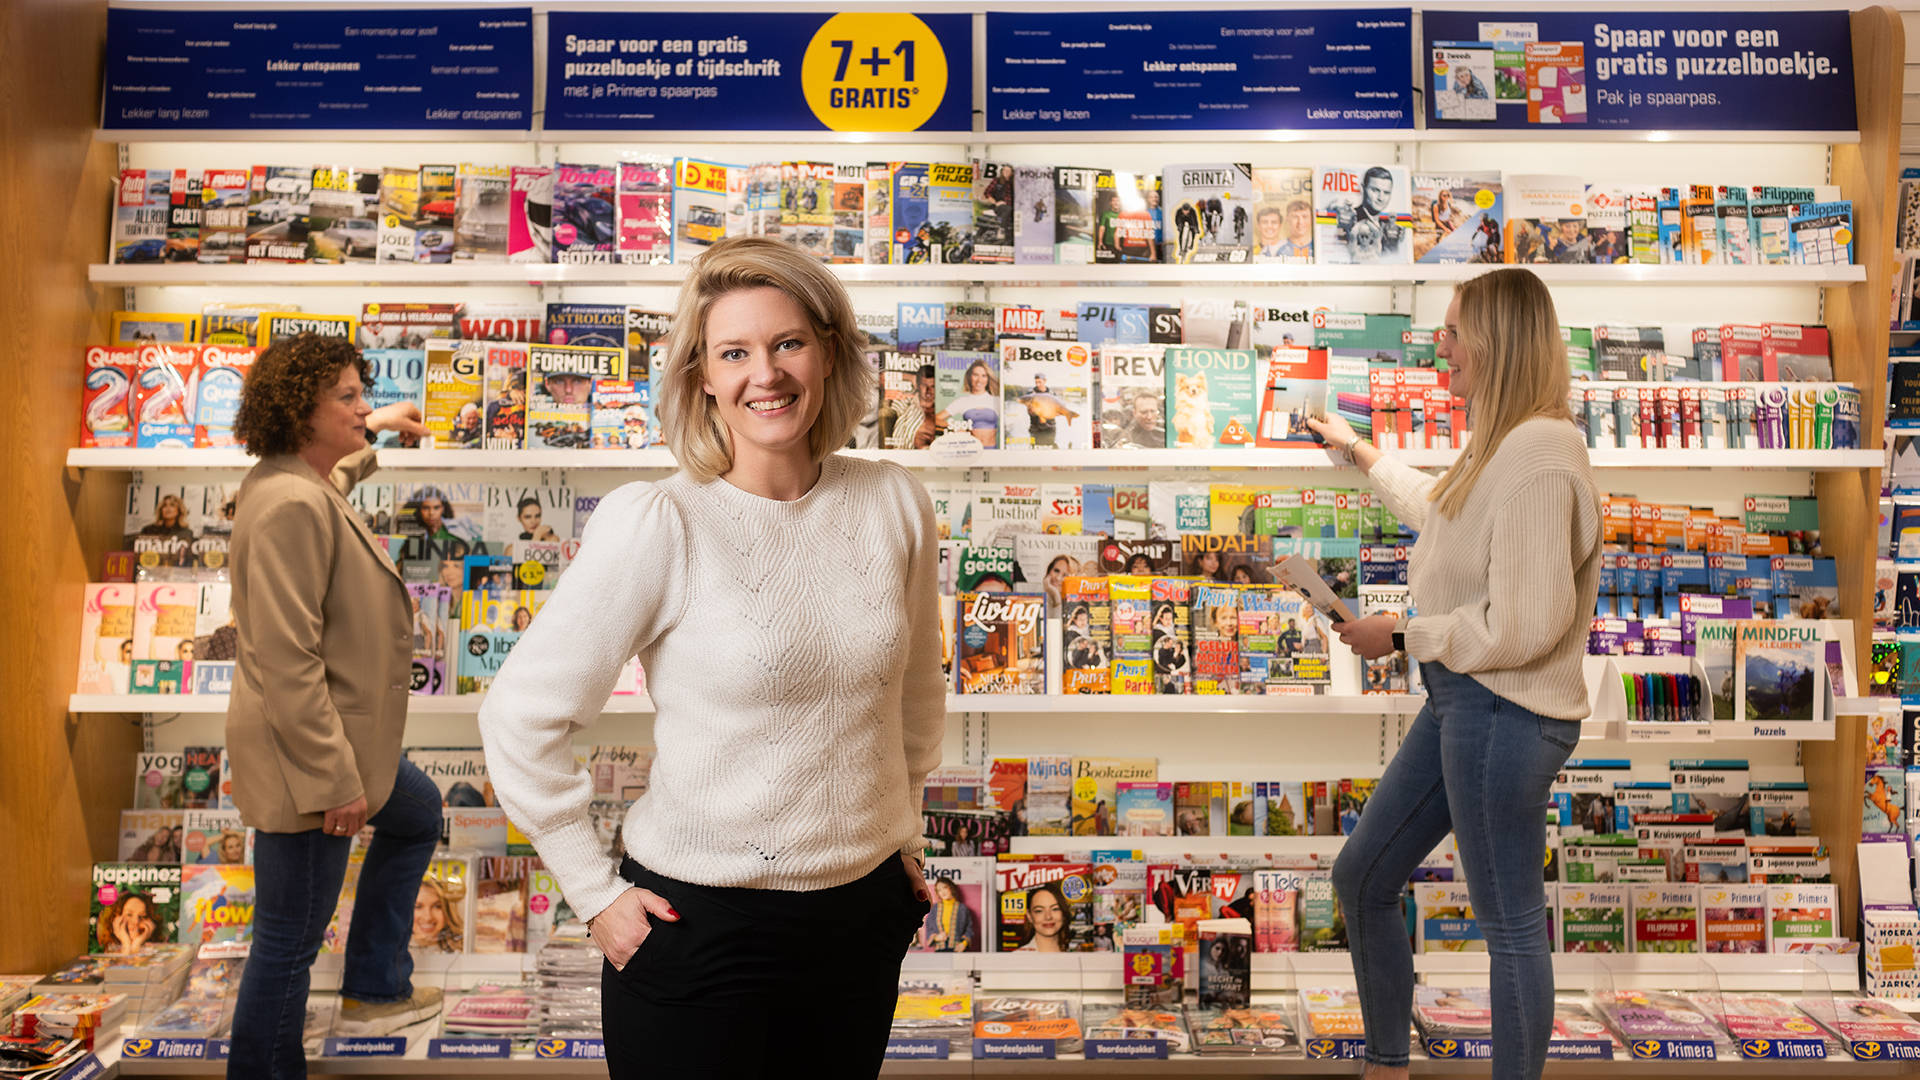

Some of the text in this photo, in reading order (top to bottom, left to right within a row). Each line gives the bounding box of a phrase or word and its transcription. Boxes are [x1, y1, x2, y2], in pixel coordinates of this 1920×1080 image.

[1594, 23, 1779, 50] Spaar voor een
[565, 35, 748, 58] Spaar voor een gratis
[267, 60, 361, 74] Lekker ontspannen
[830, 39, 915, 83] 7+1
[1143, 60, 1237, 74] Lekker ontspannen
[1596, 50, 1839, 80] gratis puzzelboekje.
[565, 58, 781, 80] puzzelboekje of tijdschrift
[564, 83, 718, 100] met je Primera spaarpas
[1596, 88, 1721, 107] Pak je spaarpas.
[122, 108, 209, 121] Lekker lang lezen
[426, 108, 522, 121] Lekker ontspannen
[1003, 108, 1090, 122] Lekker lang lezen
[1306, 108, 1403, 121] Lekker ontspannen
[1762, 186, 1815, 203] Filippine
[1800, 201, 1852, 218] Filippine
[1267, 308, 1309, 324] Beet
[1018, 346, 1063, 363] Beet
[1174, 349, 1252, 371] HOND
[530, 352, 621, 376] FORMULE 1
[963, 591, 1041, 635] Living
[1742, 627, 1822, 642] MINDFUL
[1753, 726, 1787, 738] Puzzels
[1076, 759, 1154, 780] Bookazine
[1570, 774, 1603, 784] Zweeds
[1689, 774, 1725, 785] Filippine
[1003, 897, 1025, 910] 115
[1589, 892, 1621, 905] Primera
[1661, 892, 1693, 905] Primera
[1730, 892, 1762, 905] Primera
[1797, 892, 1829, 905] Primera
[1879, 929, 1913, 938] HOERA
[157, 1040, 204, 1058] Primera
[440, 1042, 501, 1055] Voordeelpakket
[984, 1042, 1044, 1056] Voordeelpakket
[1096, 1042, 1158, 1056] Voordeelpakket
[1666, 1041, 1714, 1058] Primera
[1776, 1041, 1824, 1058] Primera
